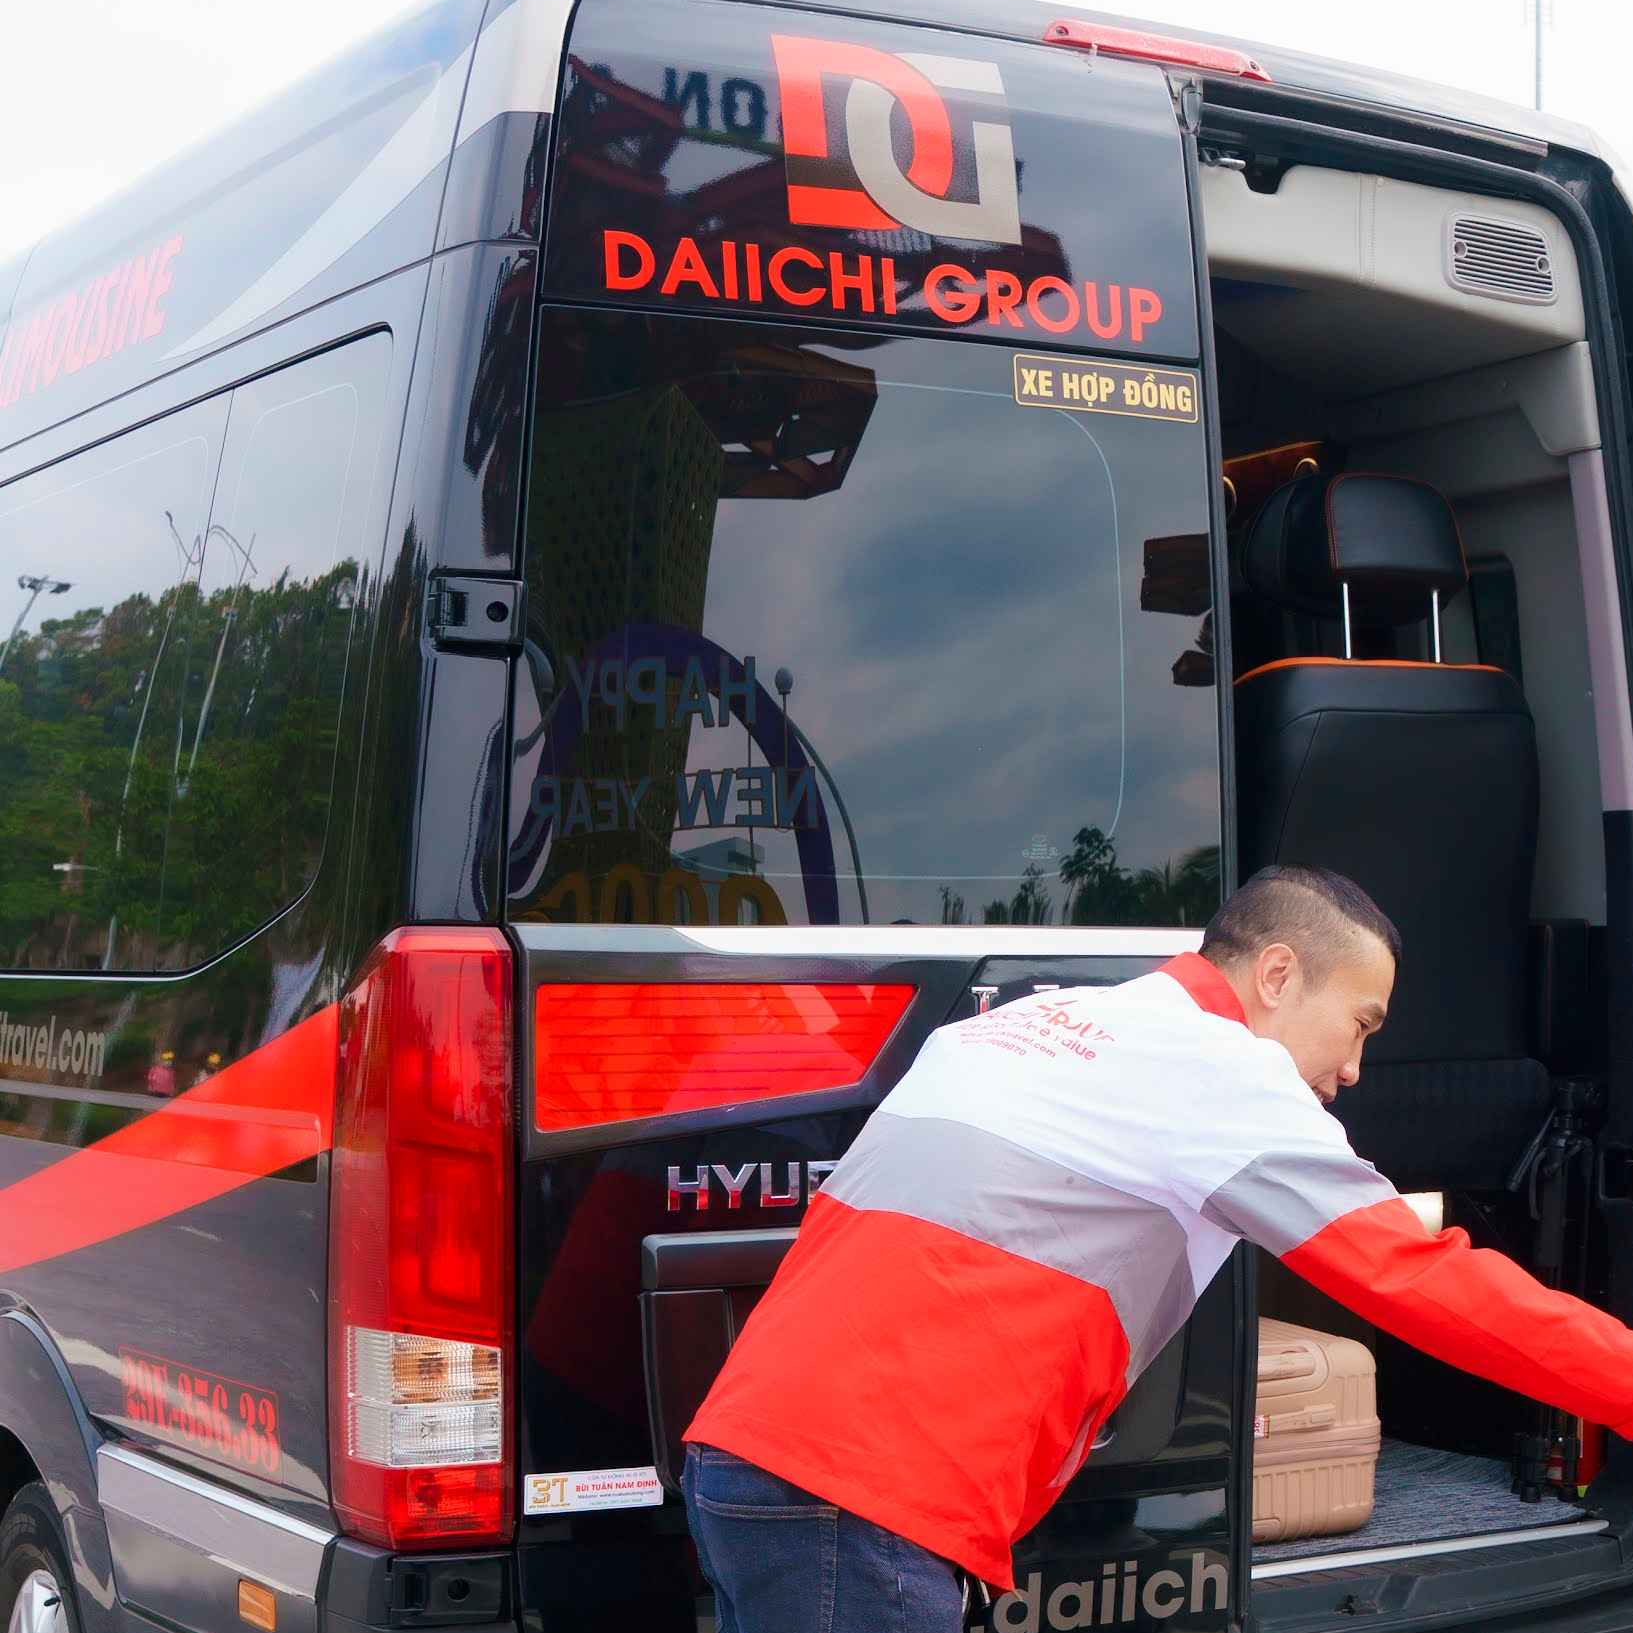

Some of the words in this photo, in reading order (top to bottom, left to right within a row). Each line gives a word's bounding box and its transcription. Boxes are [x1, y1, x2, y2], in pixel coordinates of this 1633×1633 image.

[604, 230, 896, 314] DAIICHI
[924, 264, 1163, 342] GROUP
[1021, 369, 1057, 399] XE
[1063, 371, 1116, 407] HỢP
[1125, 376, 1193, 414] ĐỒNG
